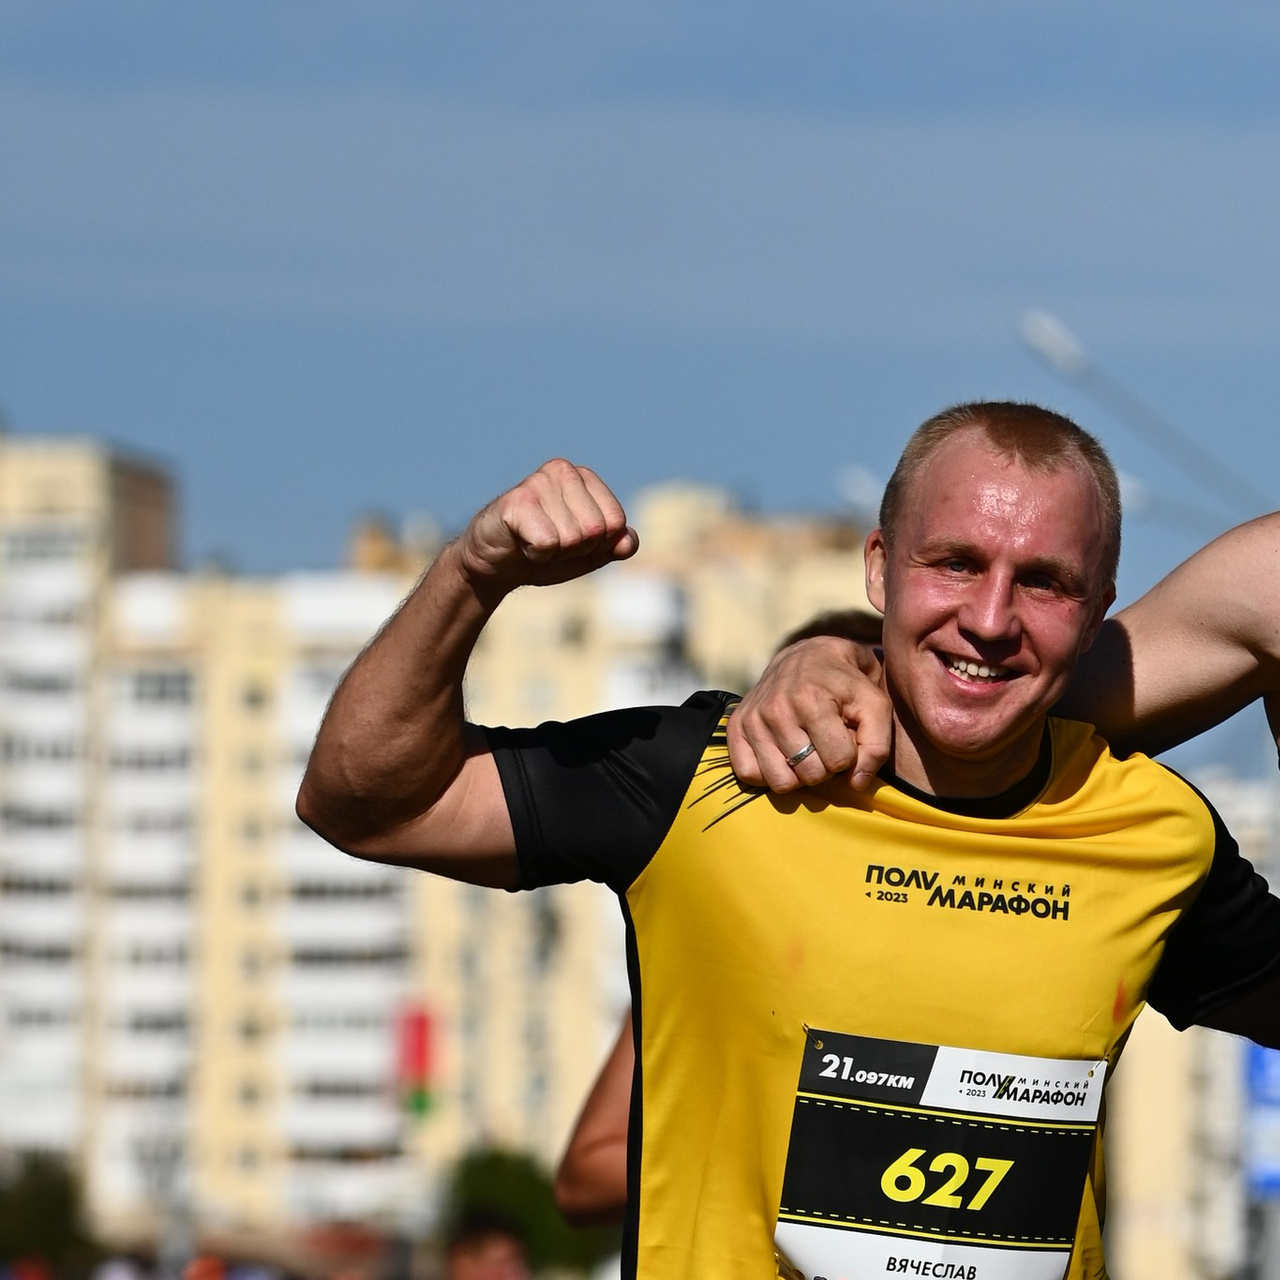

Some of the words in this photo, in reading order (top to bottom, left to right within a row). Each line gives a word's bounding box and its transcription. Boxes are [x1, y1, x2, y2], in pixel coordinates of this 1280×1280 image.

[876, 890, 908, 903] 2023
[952, 875, 1071, 897] МИНСКИЙ
[927, 885, 1070, 921] МАРАФОН
[966, 1088, 986, 1098] 2023
[1018, 1077, 1089, 1089] МИНСКИЙ
[996, 1086, 1087, 1106] МАРАФОН
[880, 1148, 1015, 1211] 627
[886, 1256, 978, 1280] ВЯЧЕСЛАВ
